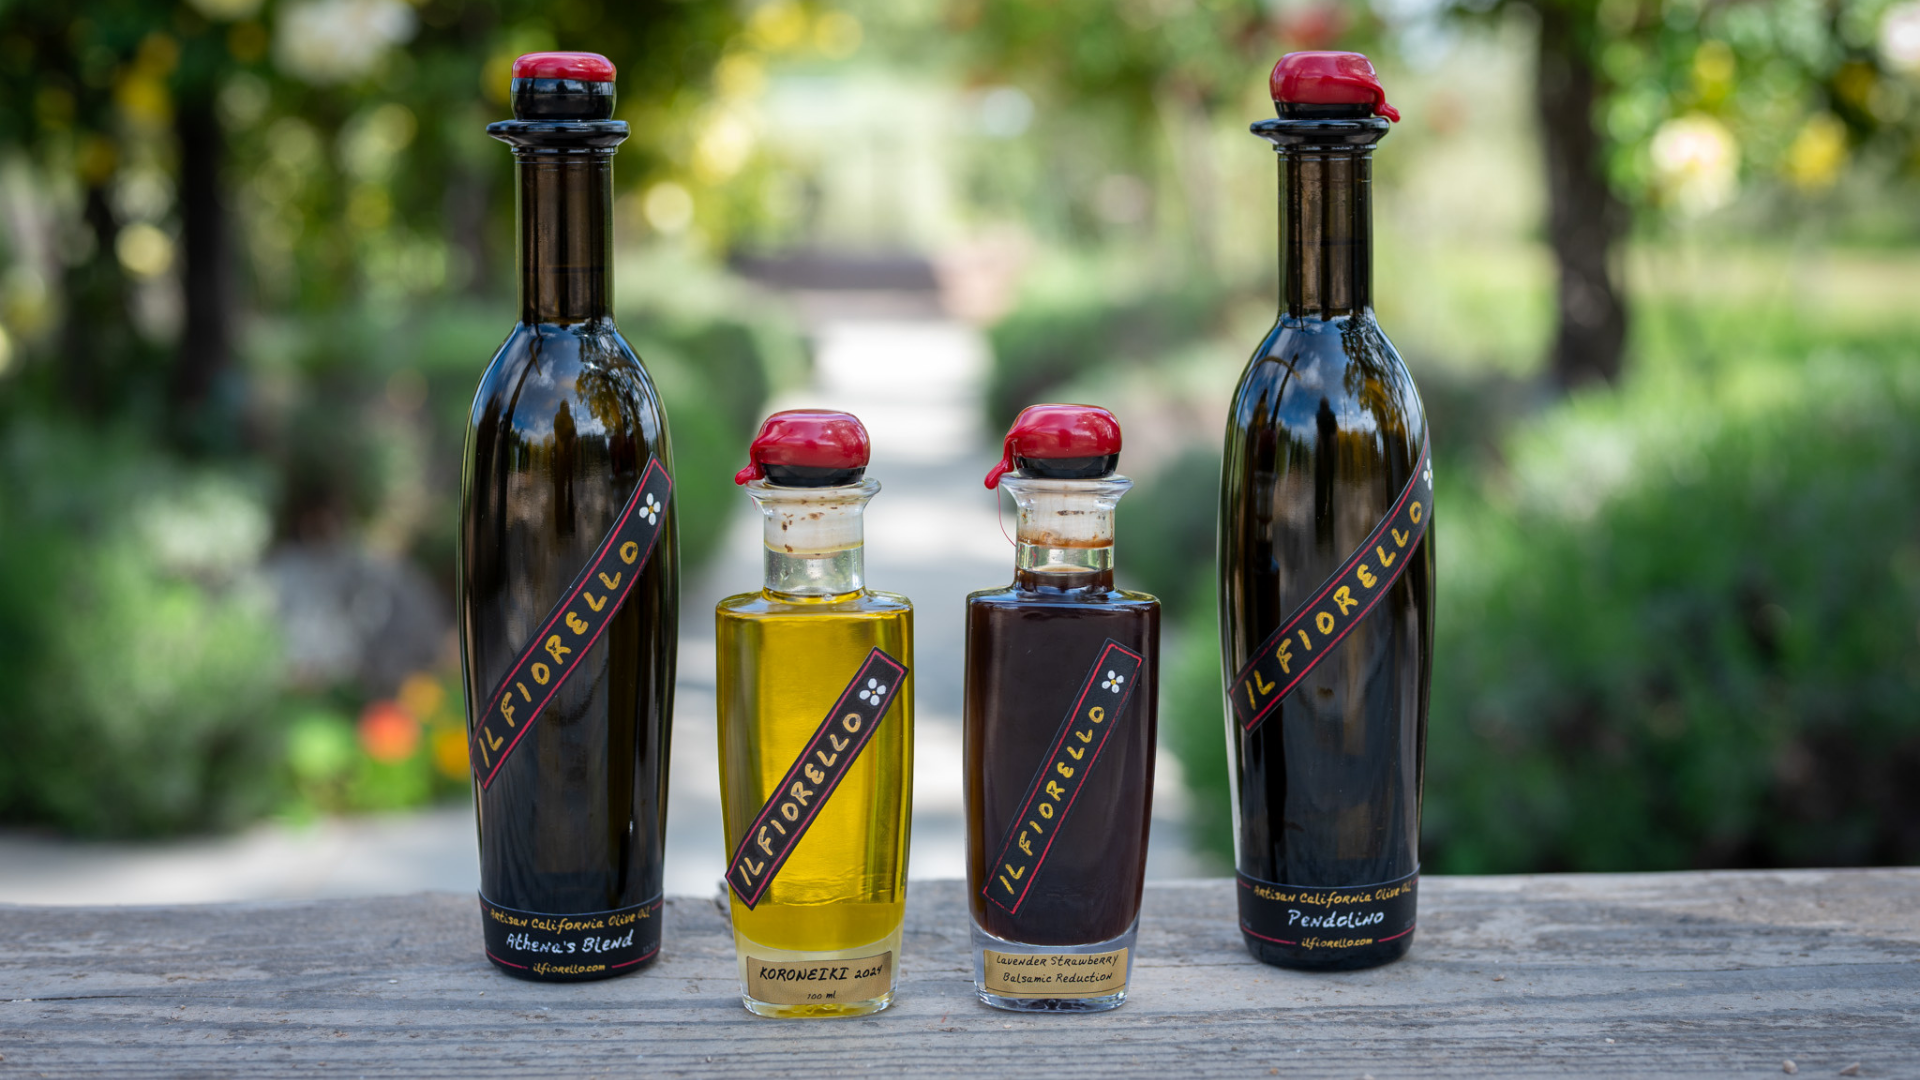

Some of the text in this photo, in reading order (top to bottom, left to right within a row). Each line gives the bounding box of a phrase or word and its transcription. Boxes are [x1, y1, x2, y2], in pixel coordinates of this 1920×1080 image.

[1245, 501, 1422, 710] IL FIORELLO
[479, 541, 638, 768] IL FIORELLO
[739, 713, 861, 886] IL FIORELLO
[999, 706, 1105, 895] IL FIORELLO
[1253, 885, 1296, 902] Artisan
[1299, 891, 1372, 908] California
[1375, 887, 1400, 900] Olive
[490, 905, 651, 934] Artisan California Olive Oil
[1288, 909, 1385, 929] Pendolino
[506, 932, 576, 954] Athena's
[582, 929, 634, 954] Blend
[1301, 937, 1373, 950] ilfiorello.com
[533, 962, 606, 976] ilfiorello.com
[1050, 954, 1119, 967] Strawberry
[759, 965, 883, 982] KORONEIKI 2024
[1003, 971, 1113, 984] Balsamic Reduction
[807, 990, 836, 1000] 100 ml
